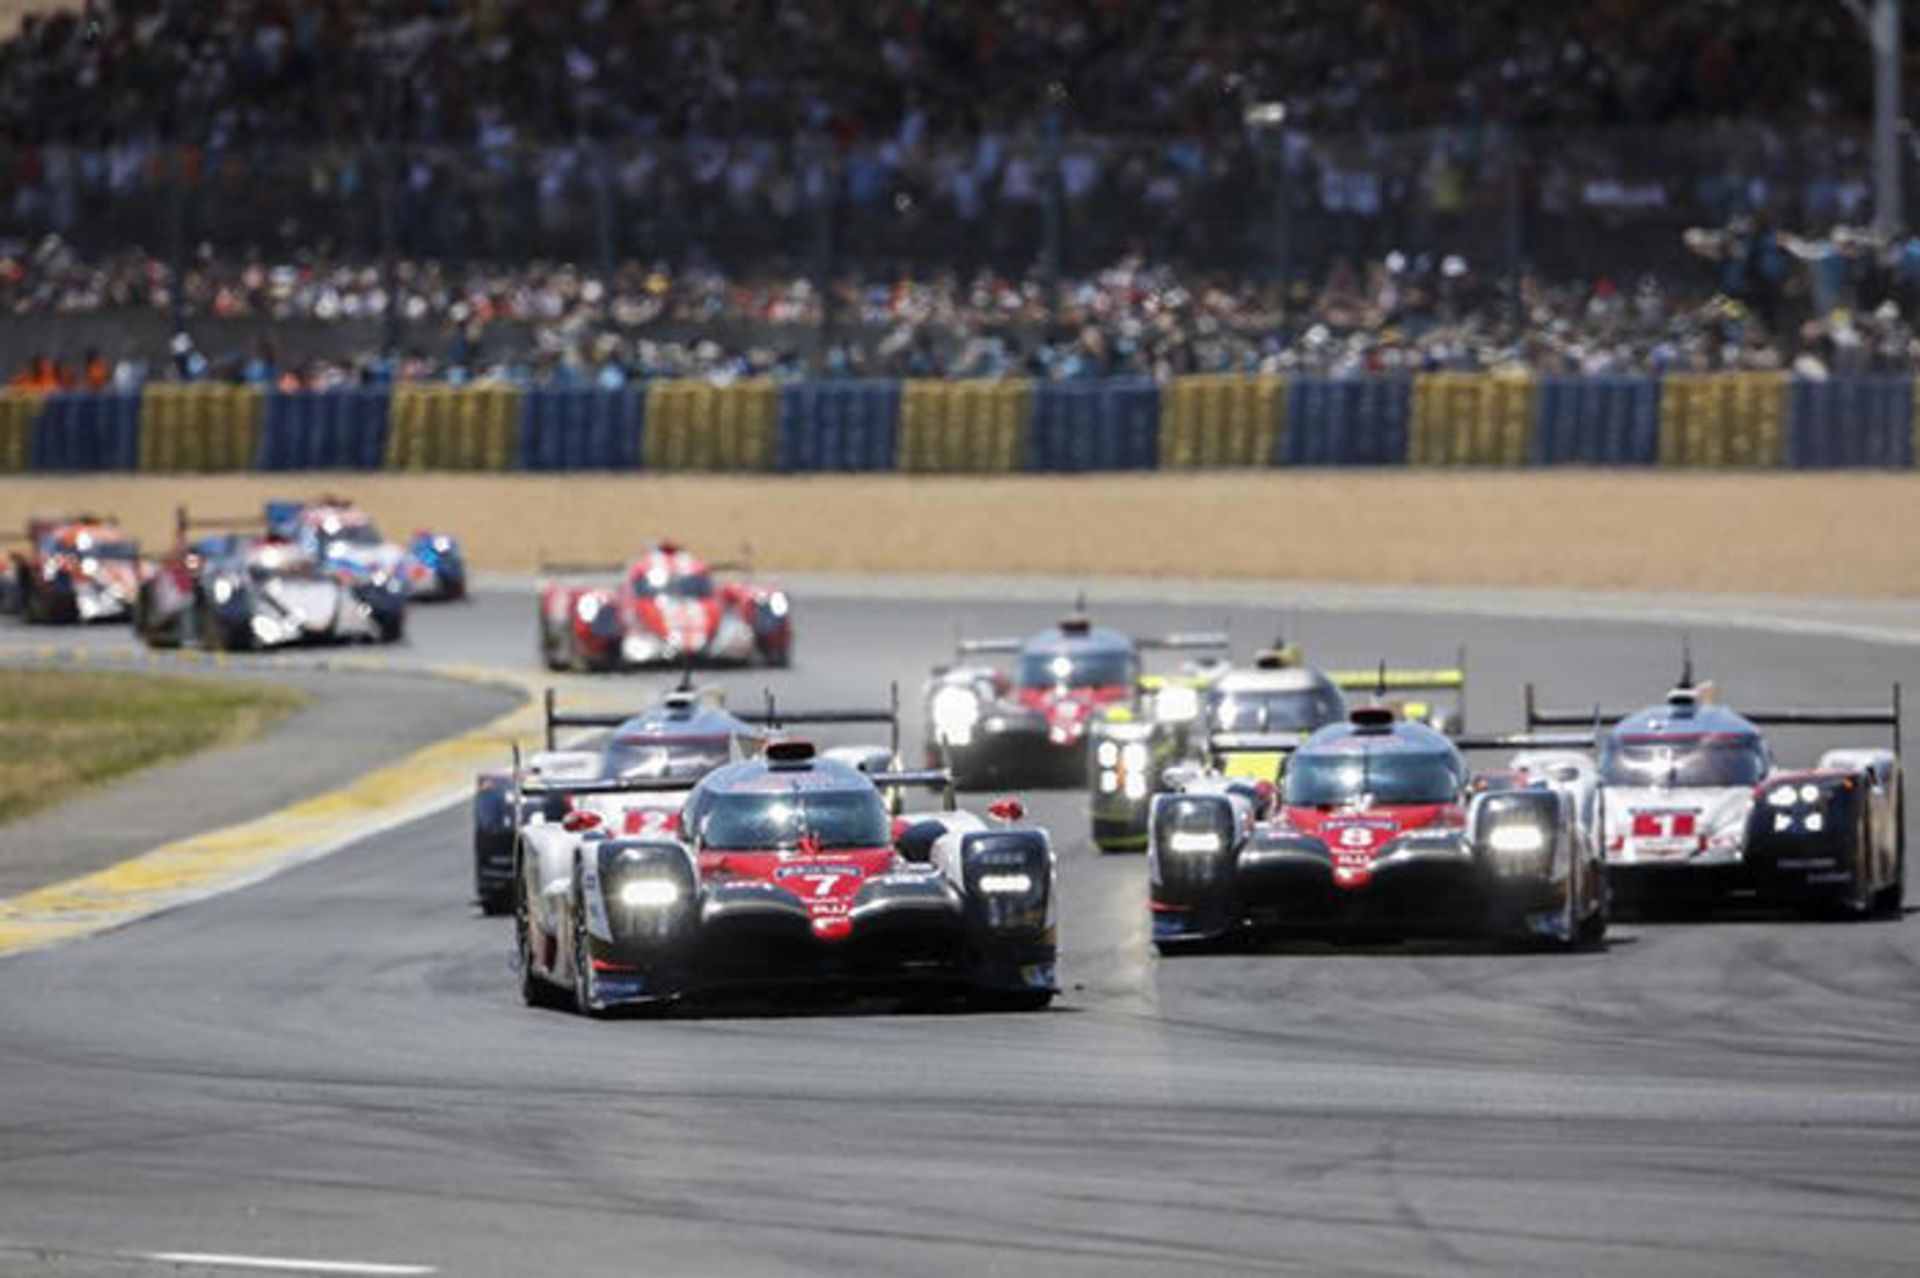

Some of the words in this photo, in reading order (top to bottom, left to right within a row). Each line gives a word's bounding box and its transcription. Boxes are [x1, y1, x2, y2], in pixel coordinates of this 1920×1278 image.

[1340, 827, 1373, 847] 8
[1651, 814, 1675, 838] 1
[803, 874, 840, 896] 7
